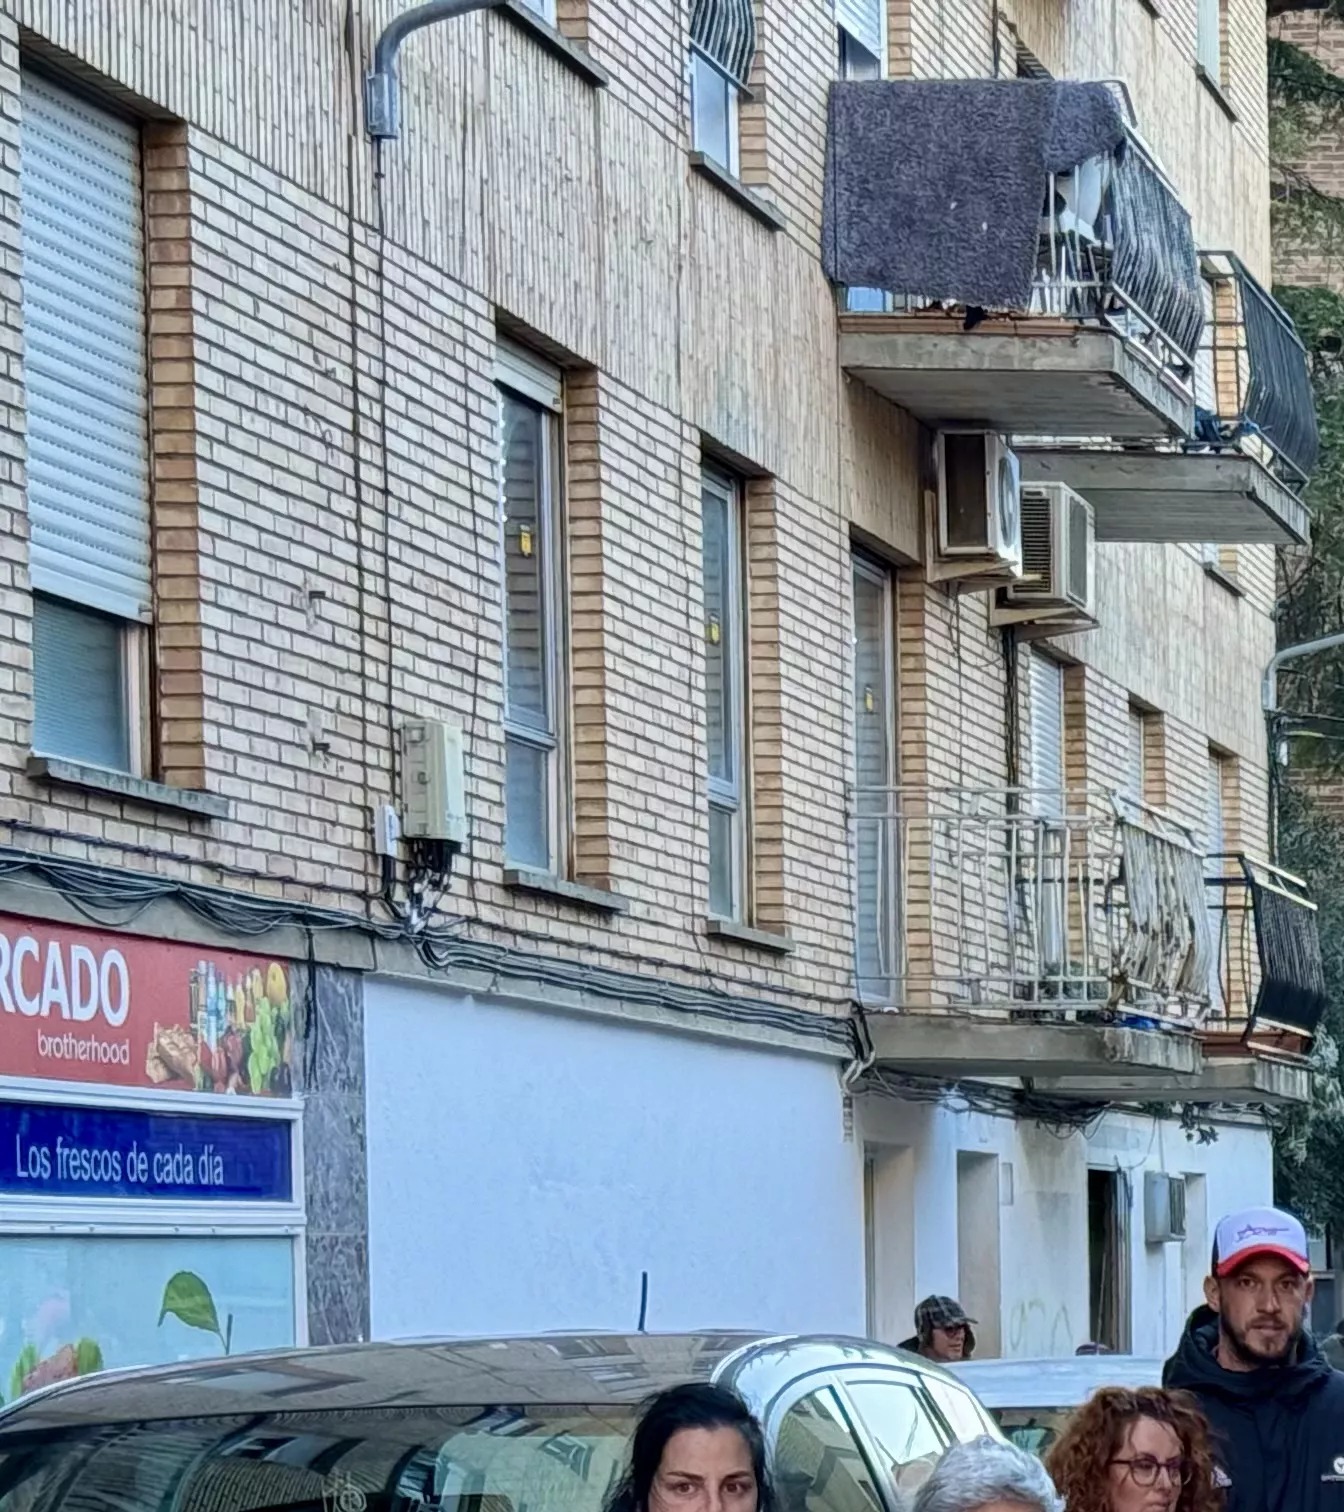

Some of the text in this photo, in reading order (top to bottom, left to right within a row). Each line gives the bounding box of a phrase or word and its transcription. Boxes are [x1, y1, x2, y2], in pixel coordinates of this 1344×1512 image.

[37, 1028, 129, 1064] brotherhood
[16, 1133, 224, 1185] Los frescos de cada día
